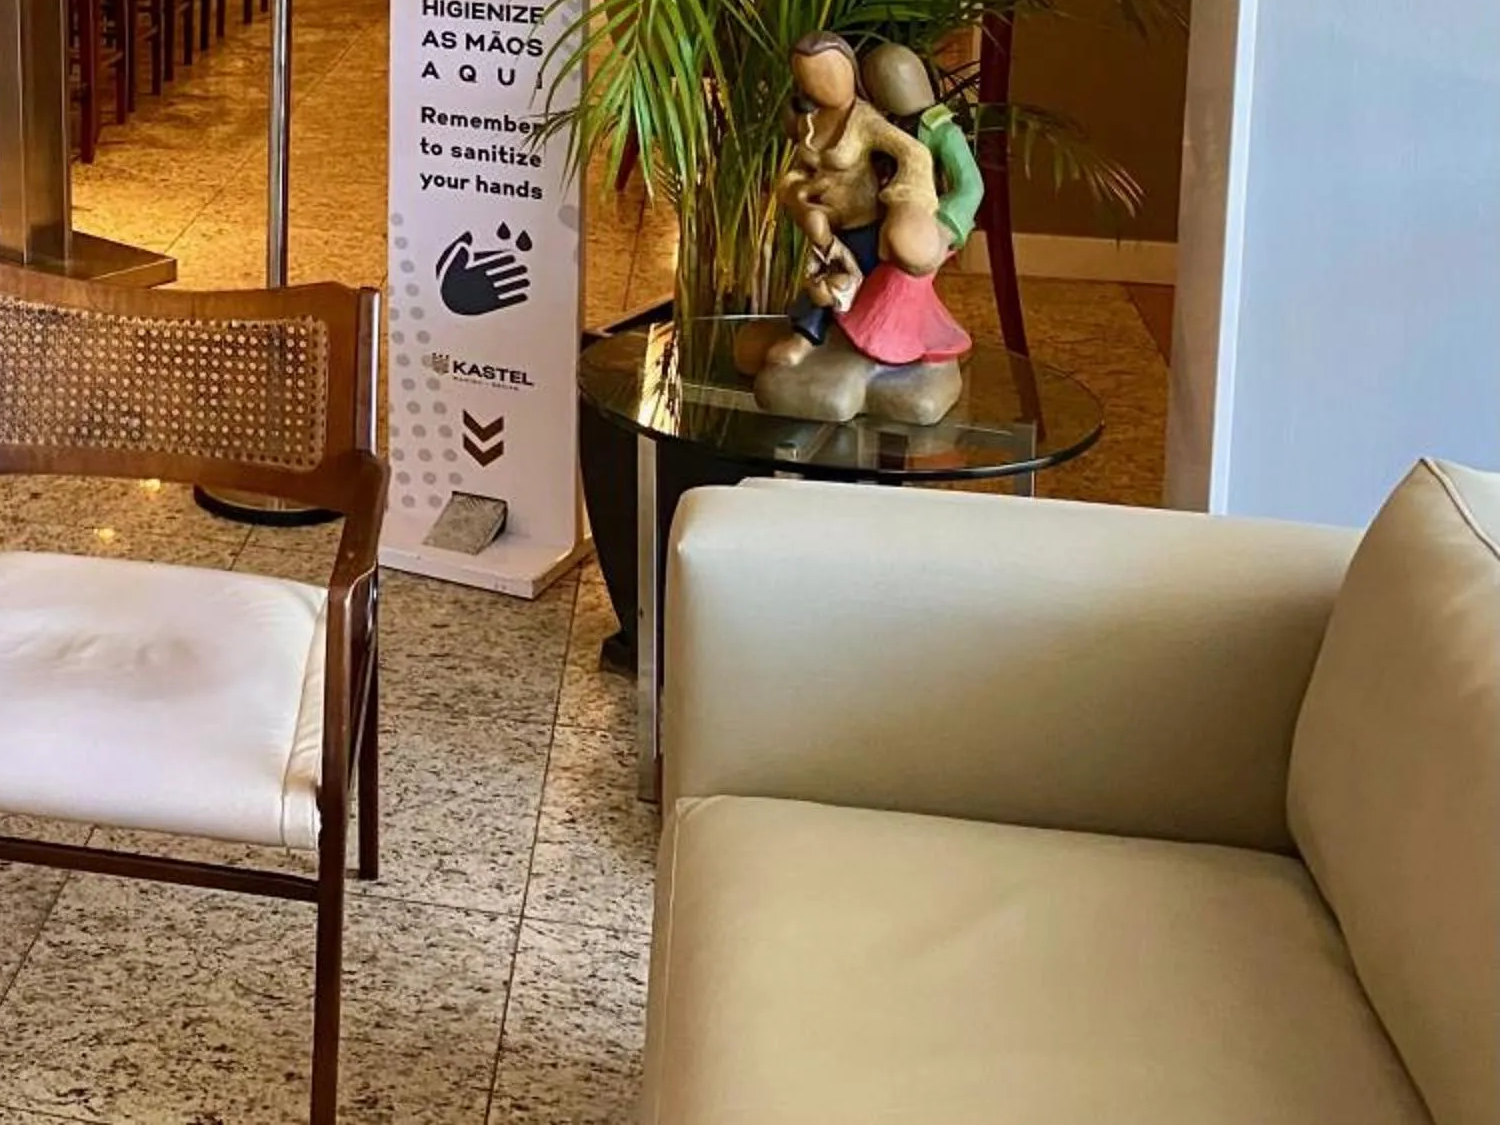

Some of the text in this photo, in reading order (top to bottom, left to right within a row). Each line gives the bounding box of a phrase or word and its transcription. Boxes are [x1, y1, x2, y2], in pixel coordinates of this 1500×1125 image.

[421, 30, 544, 57] AS MÃOS
[420, 137, 542, 168] to sanitize
[420, 173, 543, 200] your hands
[452, 360, 534, 386] KASTEL
